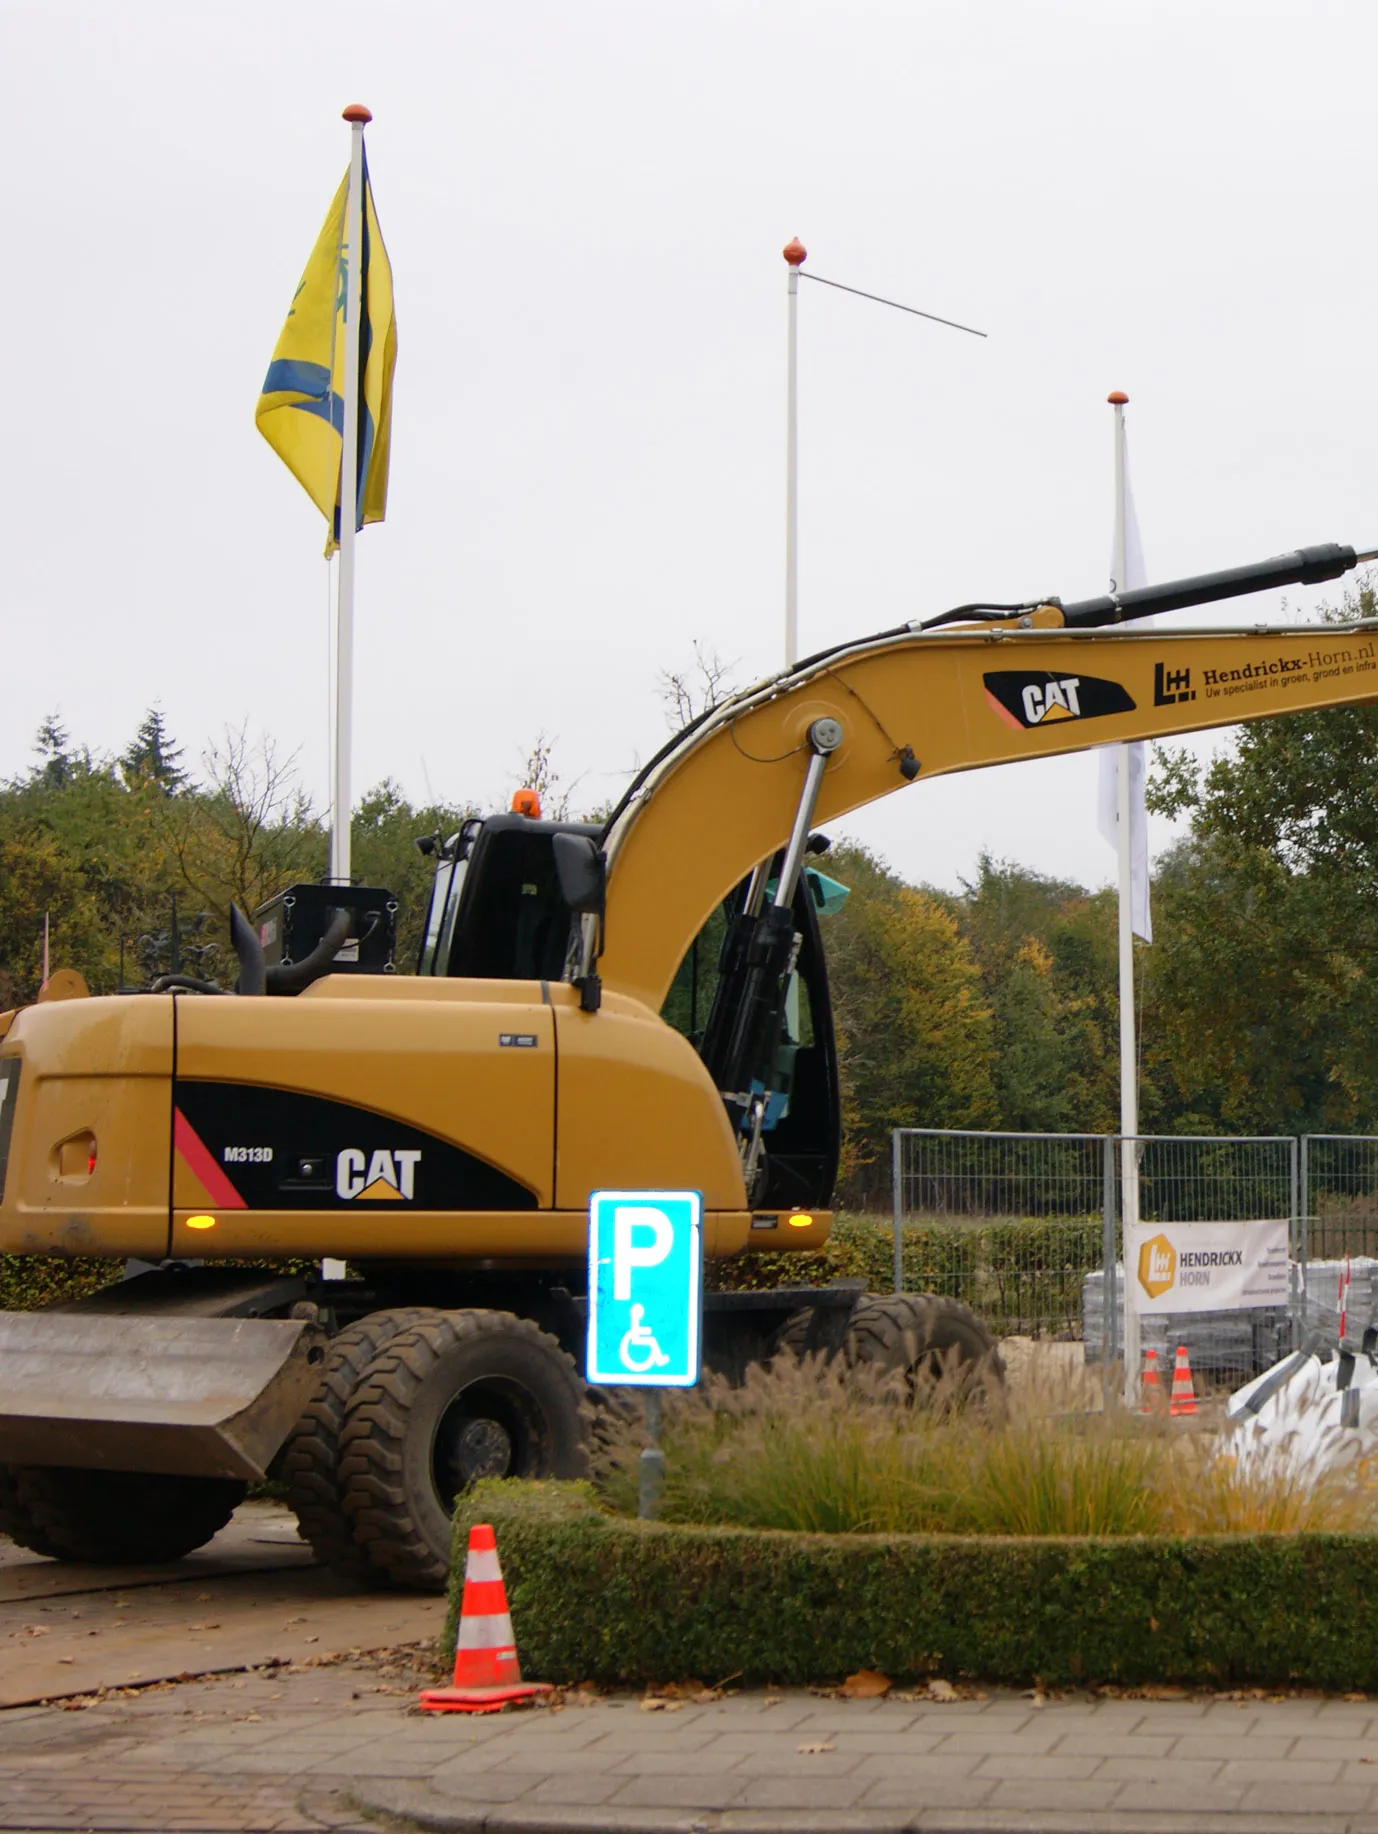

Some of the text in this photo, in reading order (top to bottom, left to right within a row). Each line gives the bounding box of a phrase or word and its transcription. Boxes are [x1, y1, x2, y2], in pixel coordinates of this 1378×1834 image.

[1203, 643, 1375, 685] Hendrickx-Horn.nl
[1205, 686, 1221, 698] Uw
[1223, 678, 1268, 697] specialist
[1270, 677, 1279, 688] in
[1313, 667, 1341, 682] grond
[1342, 664, 1354, 675] en
[1355, 660, 1377, 673] infra
[1022, 677, 1080, 724] CAT
[224, 1146, 273, 1163] M313D
[336, 1148, 422, 1200] CAT
[614, 1206, 673, 1301] P
[1180, 1251, 1243, 1268] HENDRICKX
[1180, 1271, 1211, 1286] HORN
